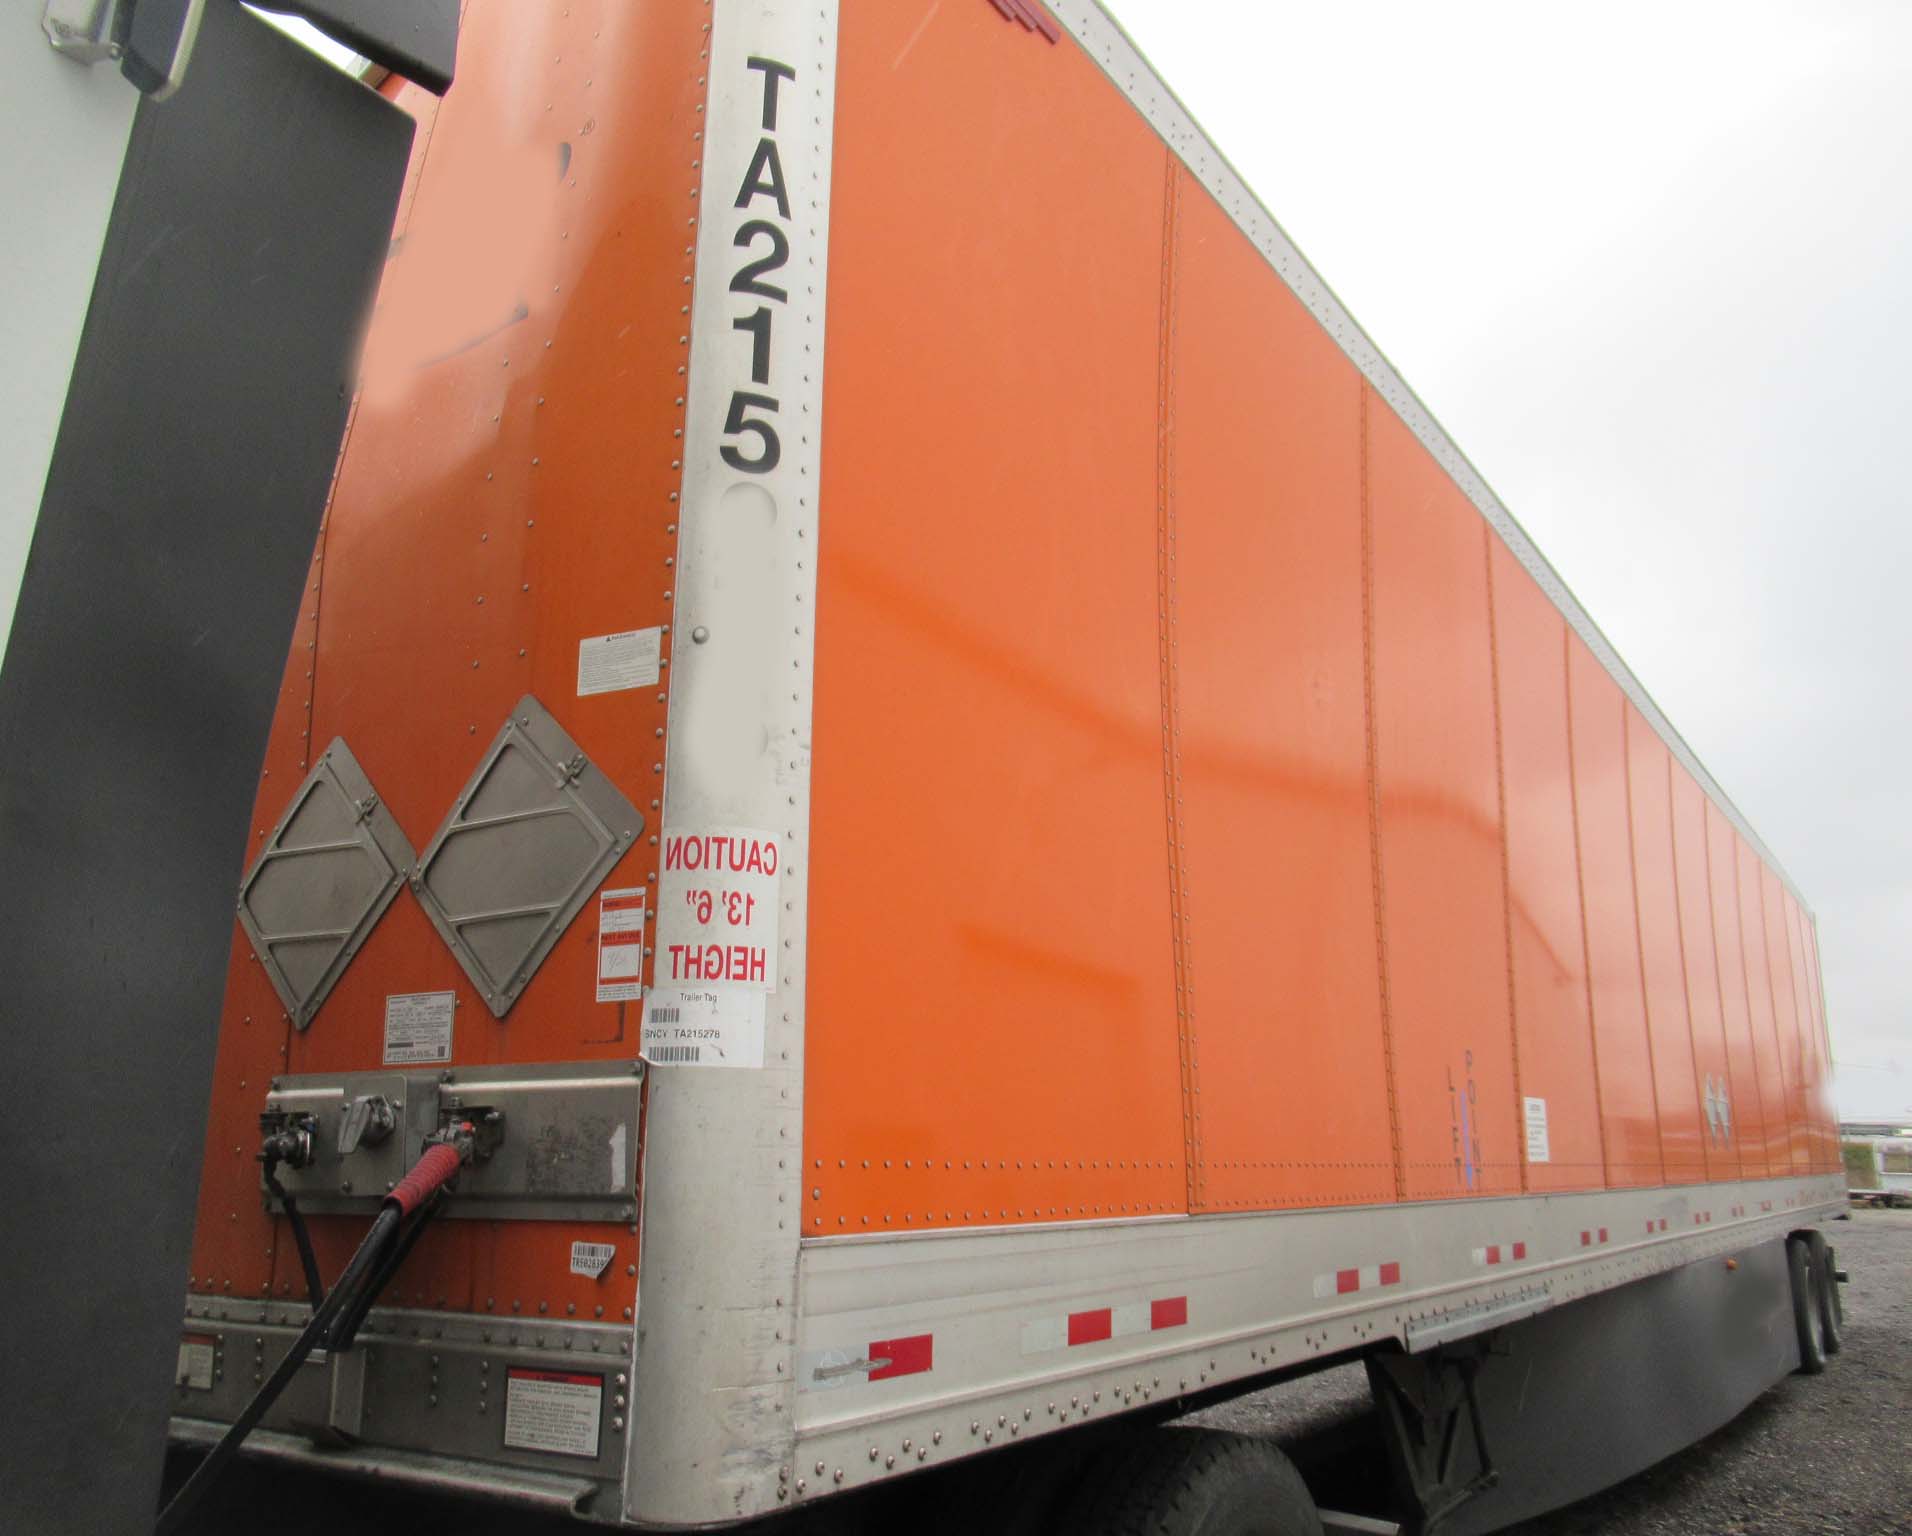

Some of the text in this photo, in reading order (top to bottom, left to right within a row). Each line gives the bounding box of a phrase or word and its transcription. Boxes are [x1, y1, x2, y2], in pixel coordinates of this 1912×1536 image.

[680, 992, 718, 1002] Trailer Tag
[674, 1029, 720, 1039] TA215278
